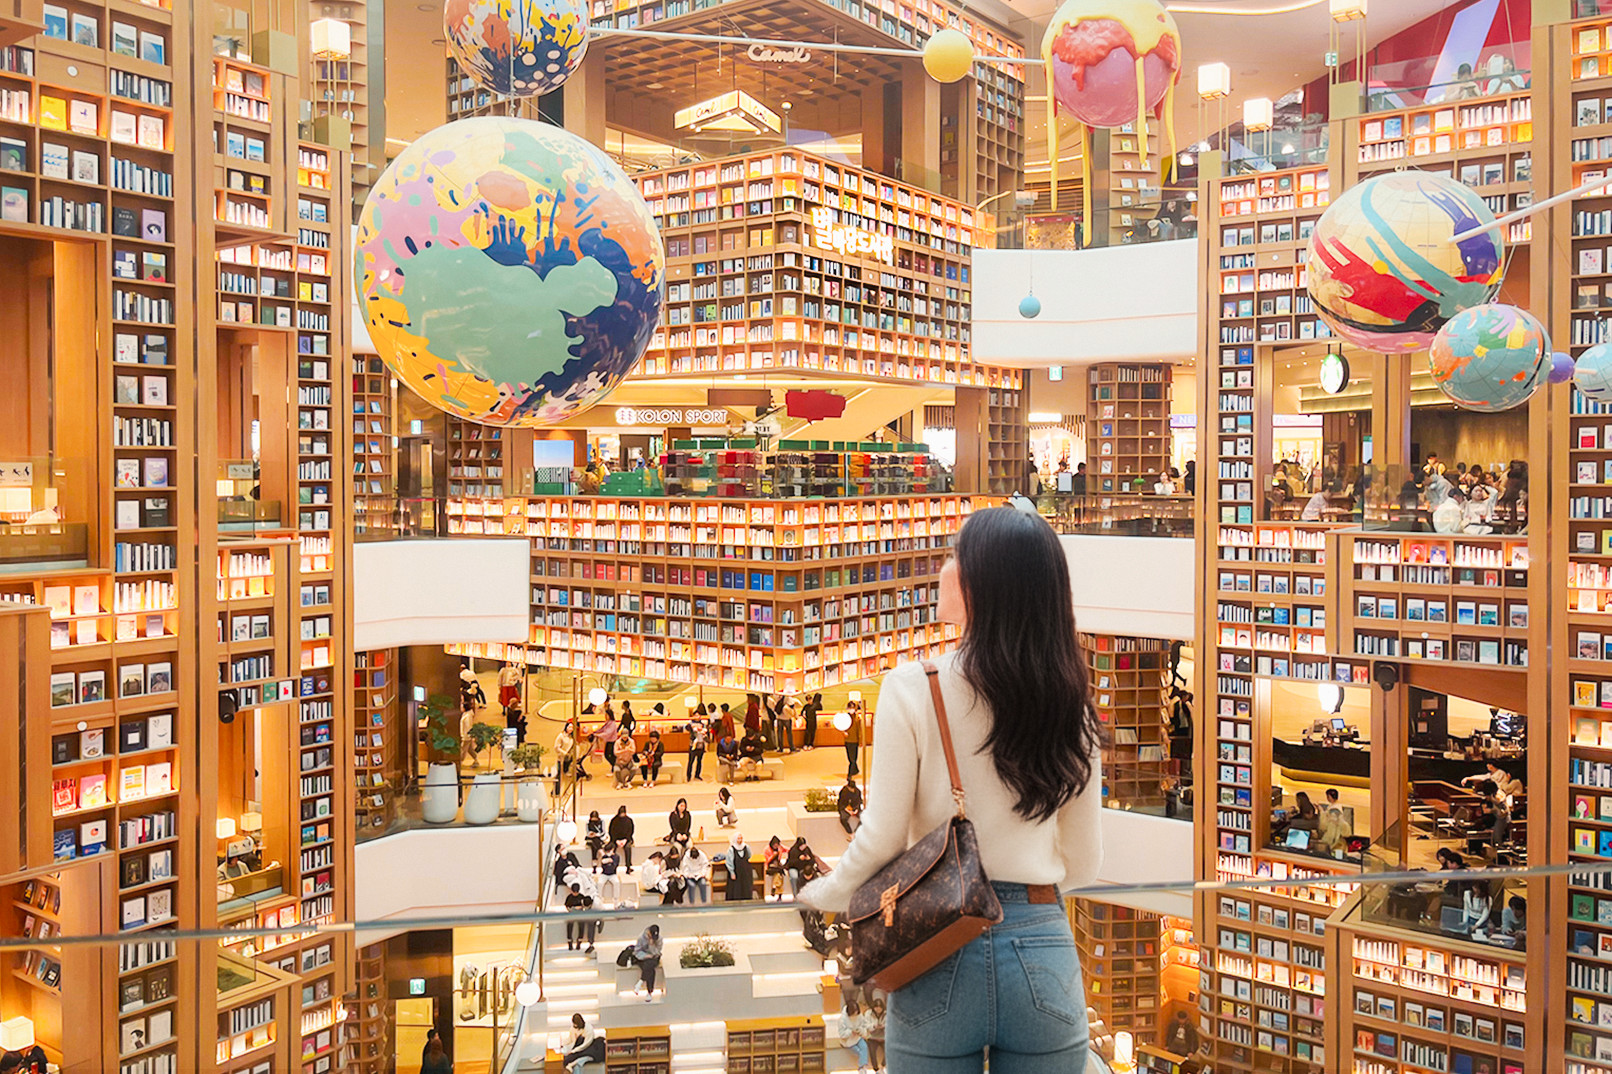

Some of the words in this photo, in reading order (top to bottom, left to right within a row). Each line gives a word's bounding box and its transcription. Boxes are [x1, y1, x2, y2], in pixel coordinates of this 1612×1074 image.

[747, 43, 811, 62] Camel
[811, 206, 893, 264] 별마당도서관
[635, 409, 683, 424] KOLON
[685, 409, 728, 424] SPORT
